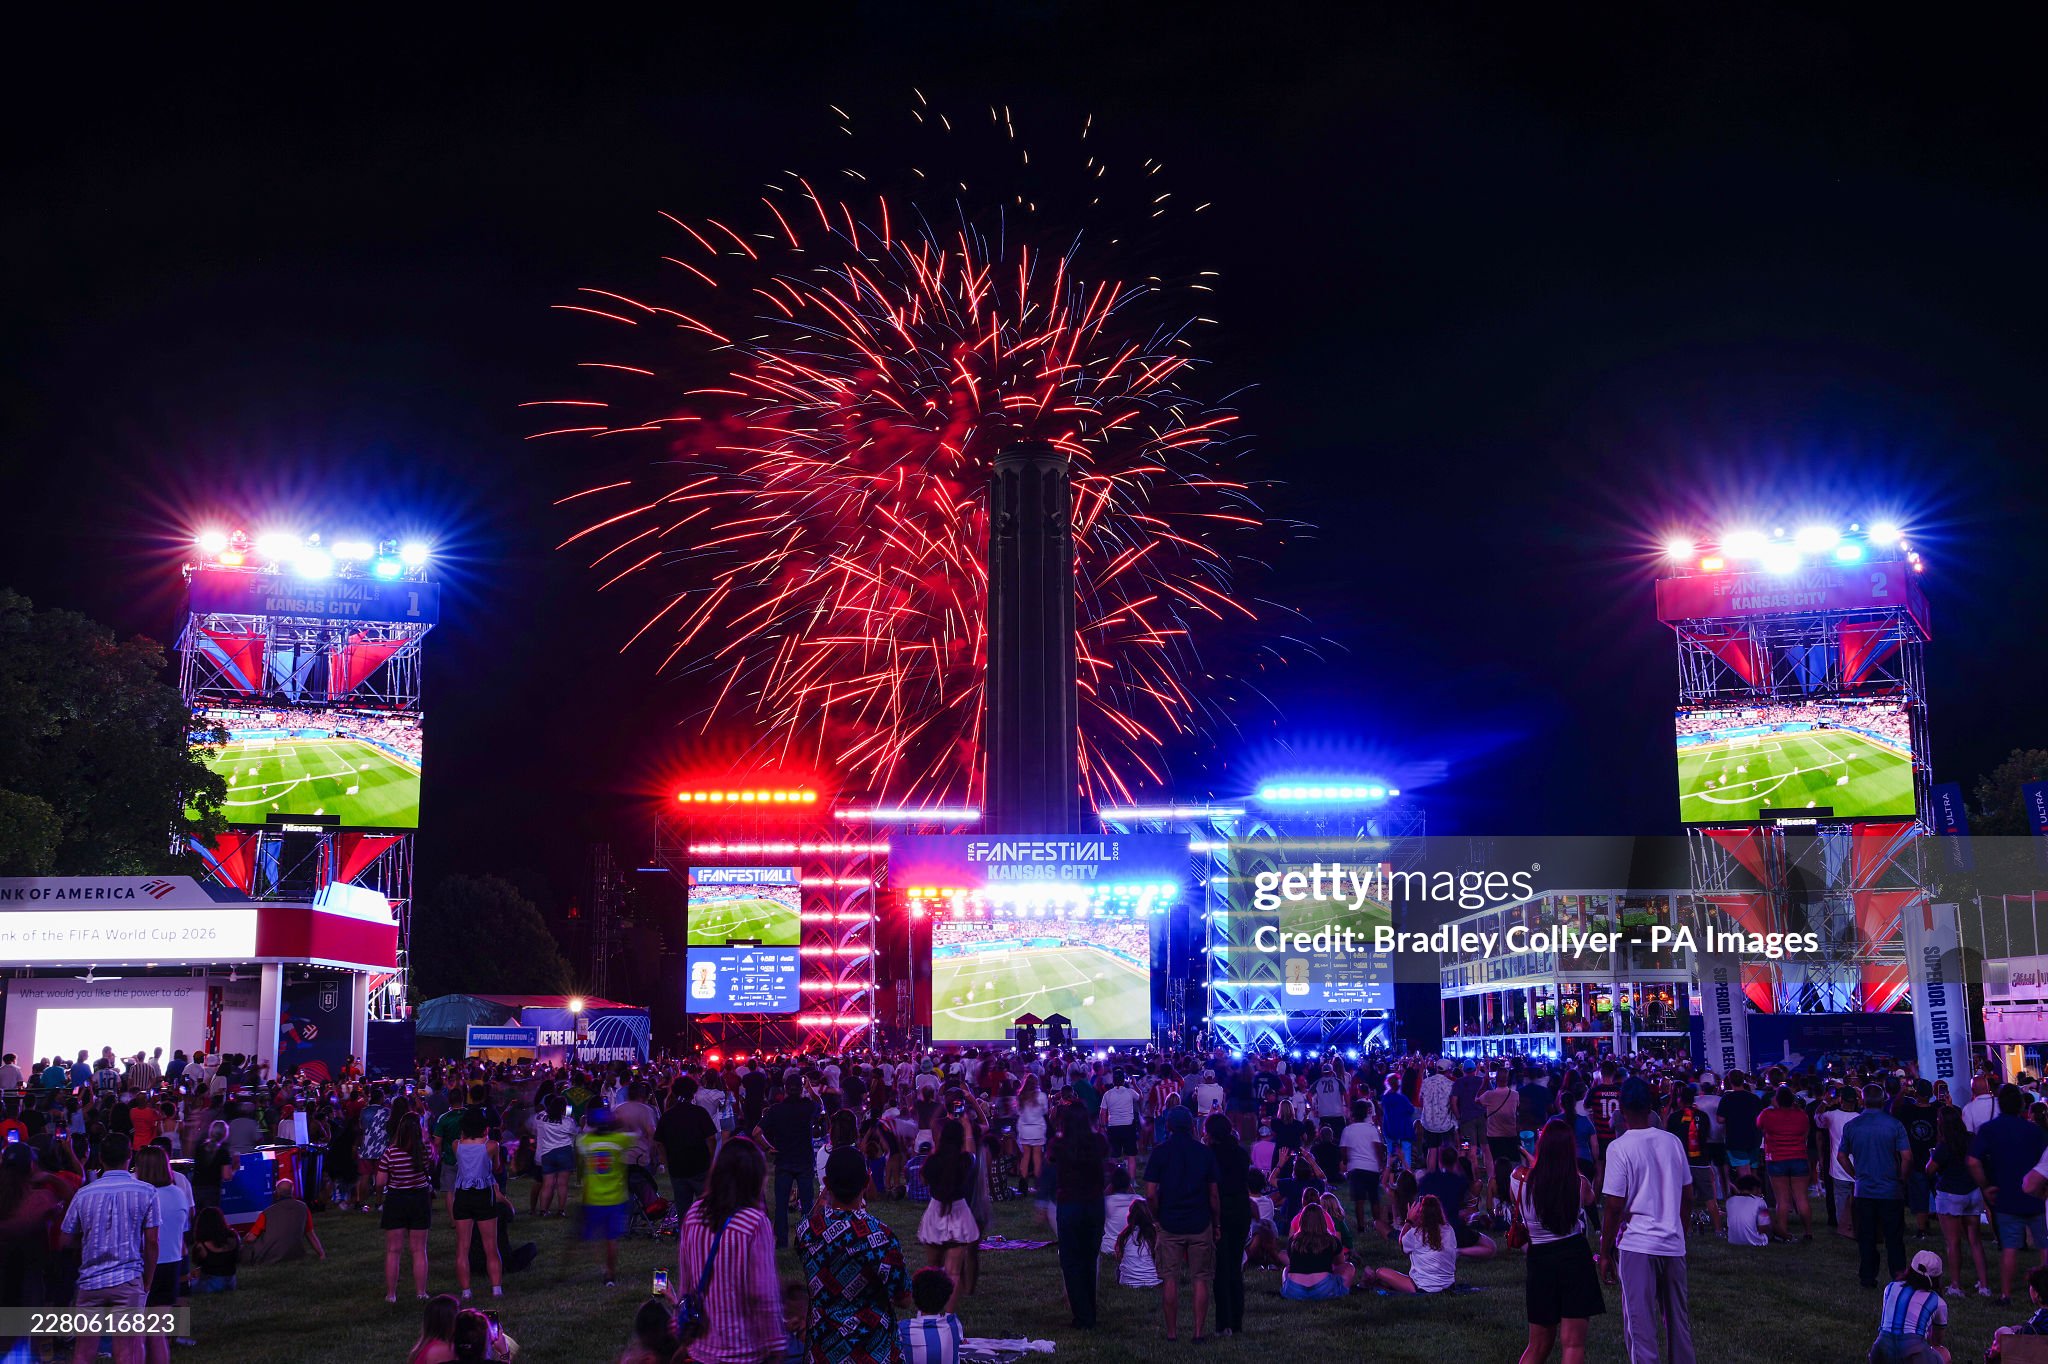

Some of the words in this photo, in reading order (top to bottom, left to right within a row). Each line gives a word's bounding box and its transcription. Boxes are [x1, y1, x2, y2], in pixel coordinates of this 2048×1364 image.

[1871, 572, 1888, 597] 2
[266, 598, 325, 613] KANSAS
[329, 600, 361, 615] CITY
[406, 591, 420, 617] 1
[1732, 594, 1793, 610] KANSAS
[1794, 592, 1826, 607] CITY
[1943, 793, 1954, 825] ULTRA
[2035, 790, 2047, 824] ULTRA
[282, 824, 323, 832] Hisense
[1776, 818, 1817, 826] Hisense
[988, 865, 1056, 880] KANSAS
[1061, 865, 1098, 880] CITY
[29, 888, 51, 900] OF
[56, 888, 135, 900] AMERICA
[23, 930, 37, 941] of
[42, 930, 64, 941] the
[69, 930, 100, 941] FIFA
[106, 929, 146, 940] World
[151, 928, 177, 942] Cup
[182, 928, 216, 940] 2026
[1923, 946, 1945, 1007] SUPERIOR
[20, 989, 44, 998] What
[47, 989, 74, 998] would
[76, 990, 93, 999] you
[95, 989, 110, 998] like
[113, 989, 129, 998] the
[130, 990, 159, 999] power
[162, 989, 171, 998] to
[174, 988, 191, 998] do?
[1713, 968, 1730, 1015] SUPERIOR
[1719, 1017, 1734, 1043] LIGHT
[1930, 1011, 1950, 1045] LIGHT
[577, 1048, 610, 1062] YOU'RE
[612, 1047, 636, 1062] HERE
[1721, 1046, 1736, 1070] BEER
[1934, 1047, 1954, 1079] BEER
[1600, 1099, 1620, 1118] 10
[829, 1220, 848, 1238] BABY
